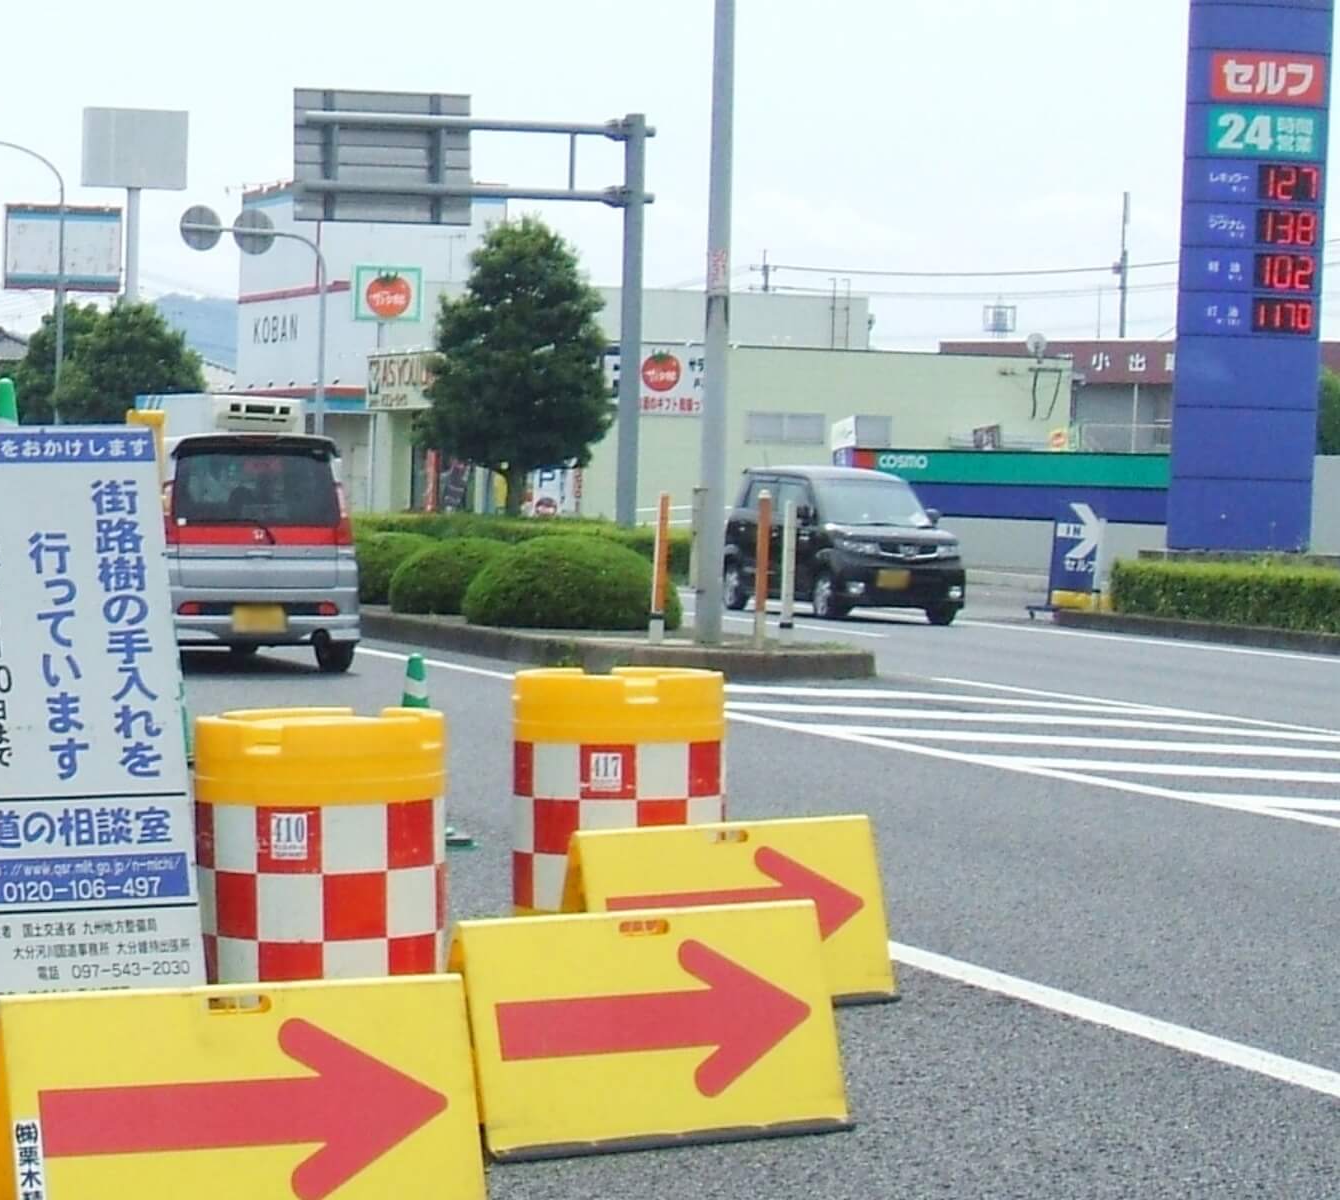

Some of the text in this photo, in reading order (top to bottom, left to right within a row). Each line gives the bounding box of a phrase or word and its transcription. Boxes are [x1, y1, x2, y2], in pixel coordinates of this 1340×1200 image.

[1222, 59, 1314, 96] セルフ
[1217, 112, 1273, 151] 24
[1266, 167, 1319, 201] 127
[1264, 211, 1316, 245] 138
[1262, 255, 1314, 290] 102
[253, 314, 298, 344] KOBAN
[1258, 303, 1312, 330] 1170
[90, 480, 162, 778] 街路樹の手入れを
[28, 531, 90, 780] 行っています
[591, 755, 621, 778] 417
[272, 815, 305, 843] 410
[3, 876, 162, 902] 0120-106-497
[22, 920, 77, 937] 国土交通省
[83, 917, 158, 934] 九州地方整備局
[13, 941, 110, 960] 大分河川国道事務所
[37, 959, 191, 981] 電話 097-543-2030
